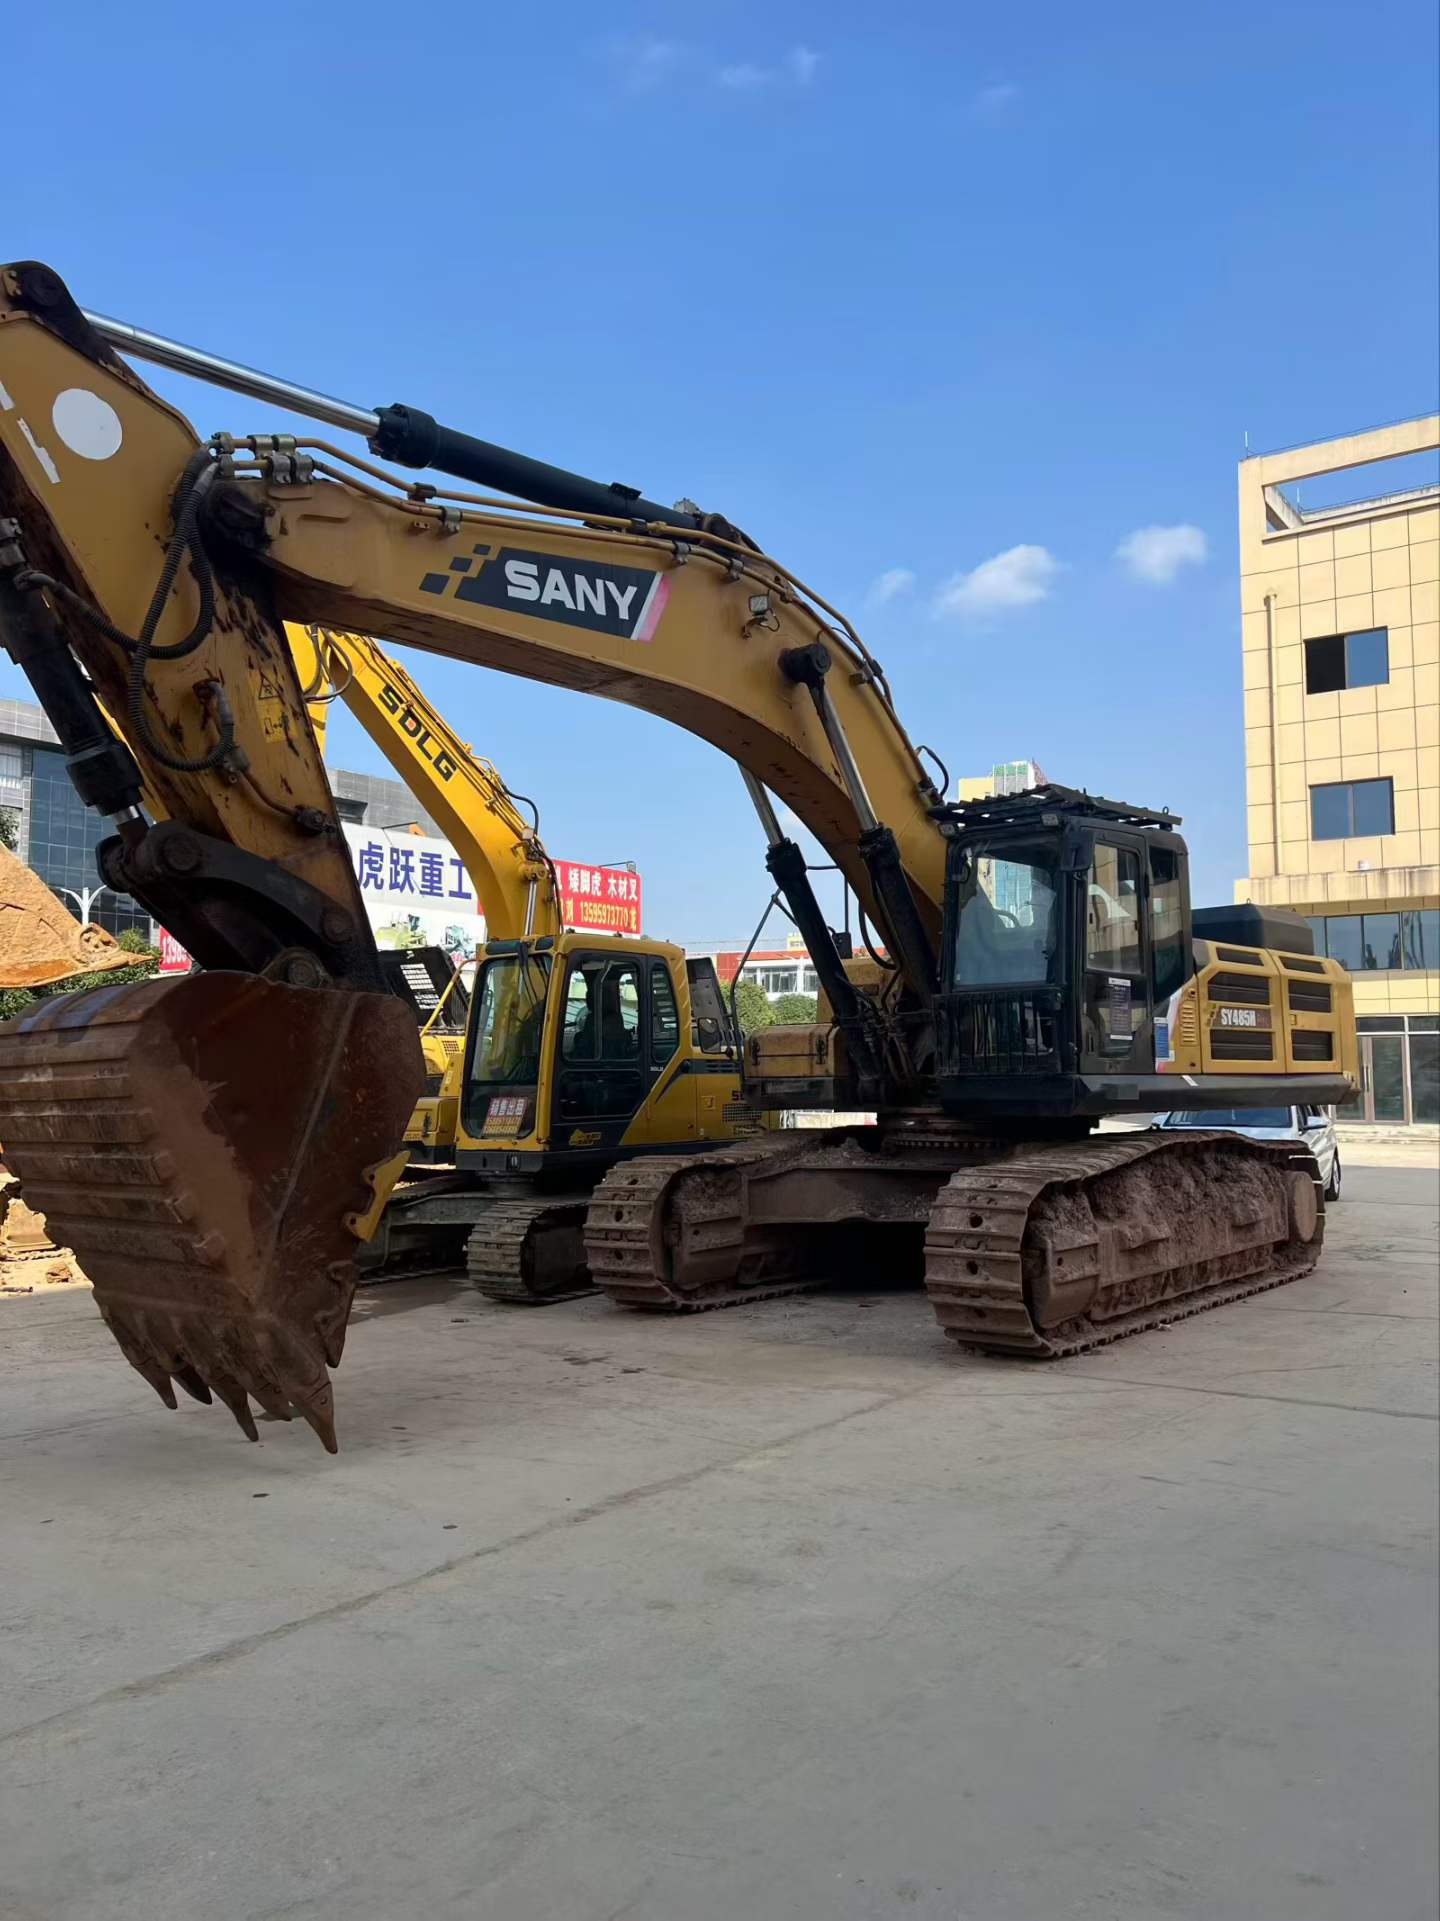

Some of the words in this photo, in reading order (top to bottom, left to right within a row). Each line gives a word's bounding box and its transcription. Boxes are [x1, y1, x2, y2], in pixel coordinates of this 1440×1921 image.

[504, 559, 637, 620] SANY
[378, 683, 457, 781] SDLG
[359, 841, 472, 900] 虎跃重工
[1221, 1008, 1256, 1027] SY485H
